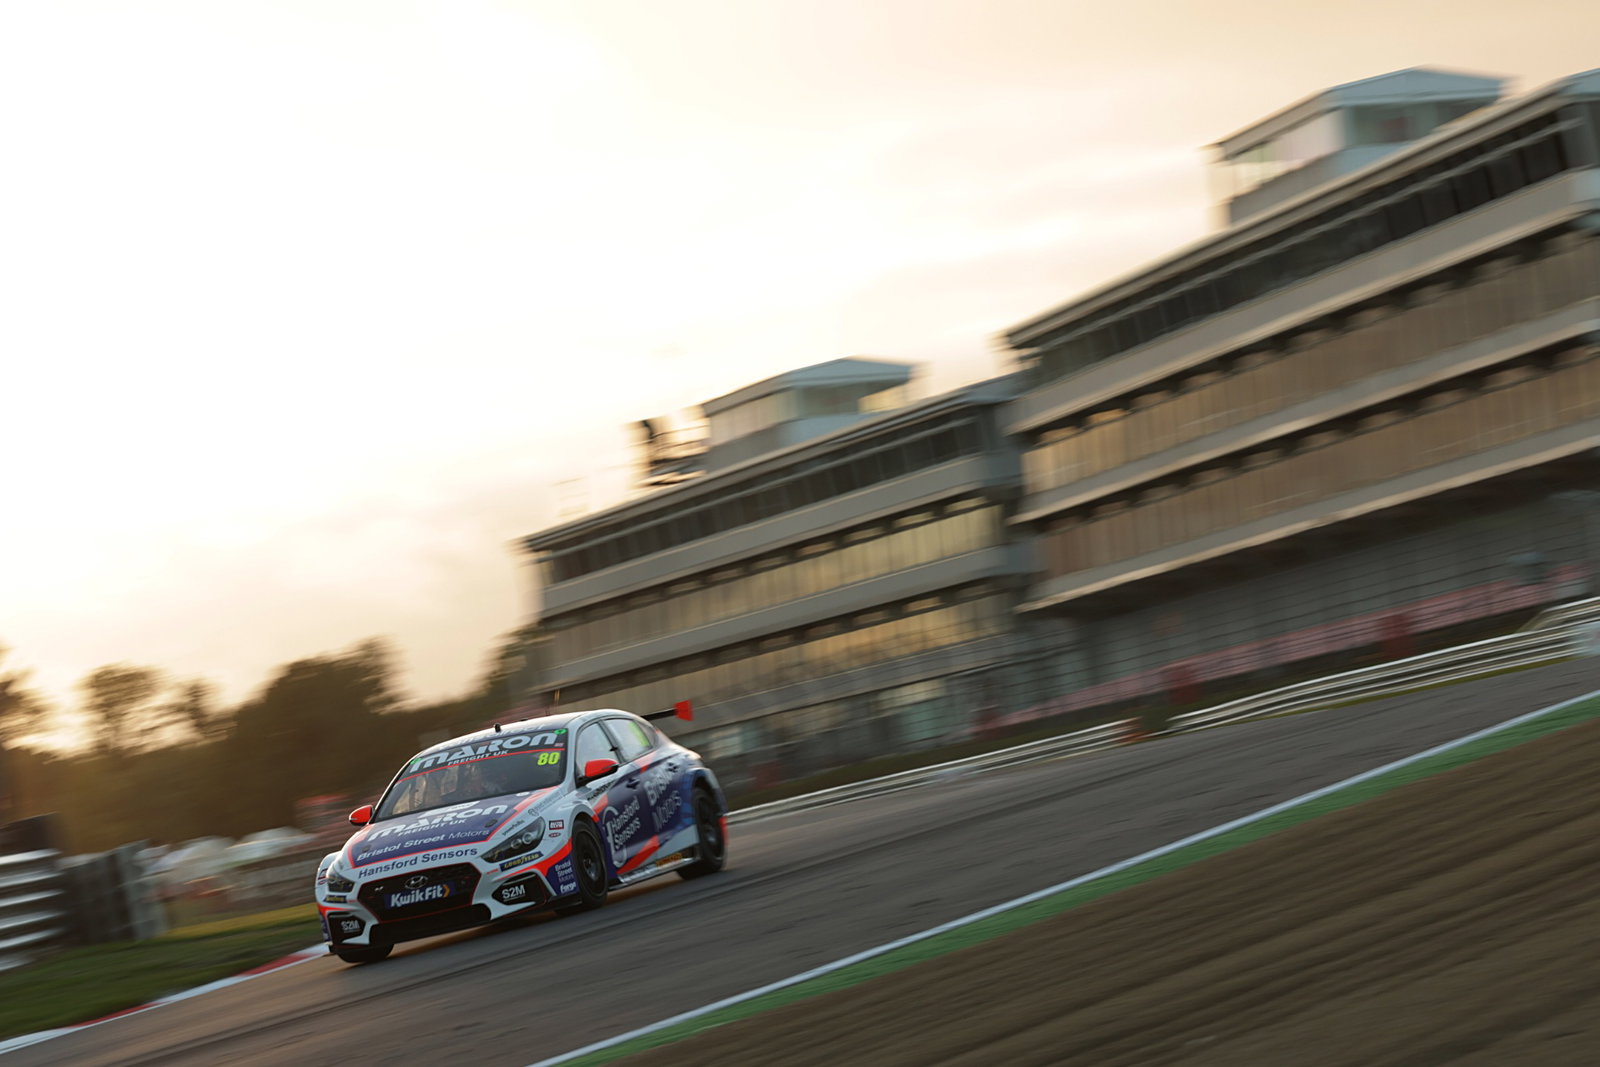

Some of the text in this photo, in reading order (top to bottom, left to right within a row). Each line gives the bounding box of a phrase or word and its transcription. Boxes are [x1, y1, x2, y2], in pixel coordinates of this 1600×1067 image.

[448, 749, 508, 766] FREIGHT UK
[537, 752, 560, 766] 80
[611, 795, 641, 833] Hansford
[398, 818, 468, 837] FREIGHT UK
[613, 817, 641, 850] Sensors
[356, 829, 490, 862] Bristol Street Motors
[358, 848, 478, 879] Hansford Sensors
[501, 884, 526, 899] S2M
